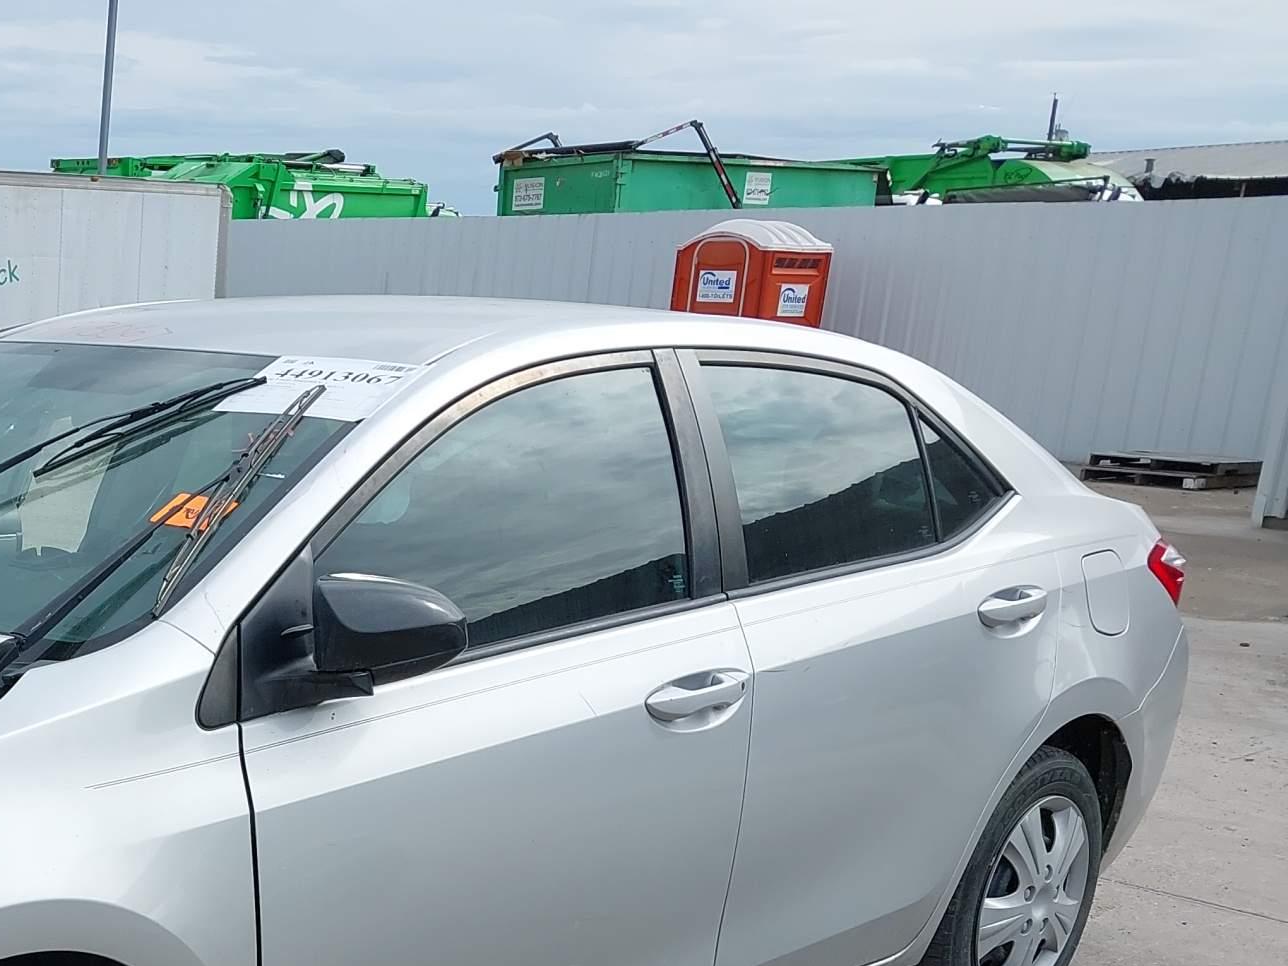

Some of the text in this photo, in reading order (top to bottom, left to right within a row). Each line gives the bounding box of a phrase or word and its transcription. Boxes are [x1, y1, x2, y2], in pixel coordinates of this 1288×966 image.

[702, 276, 731, 286] United
[782, 293, 808, 304] United
[274, 368, 404, 385] 44913067
